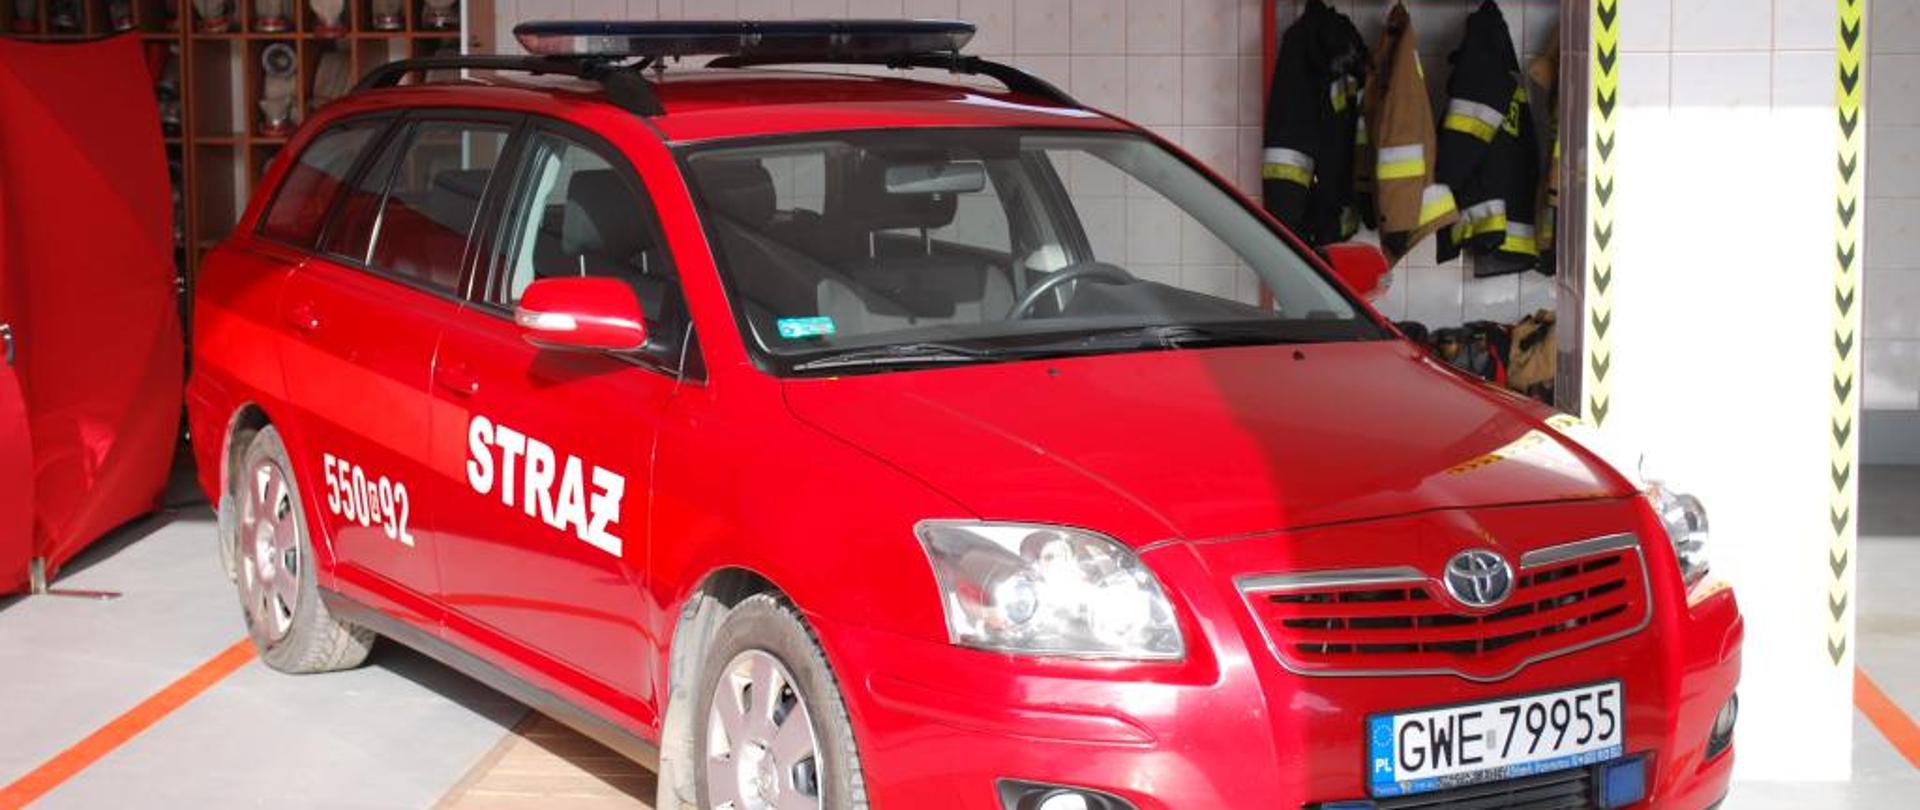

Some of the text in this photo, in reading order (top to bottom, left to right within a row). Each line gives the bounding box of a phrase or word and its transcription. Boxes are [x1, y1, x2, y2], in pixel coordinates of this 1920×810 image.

[1399, 711, 1482, 772] GWE
[1500, 690, 1614, 758] 79955
[1375, 758, 1392, 772] PL
